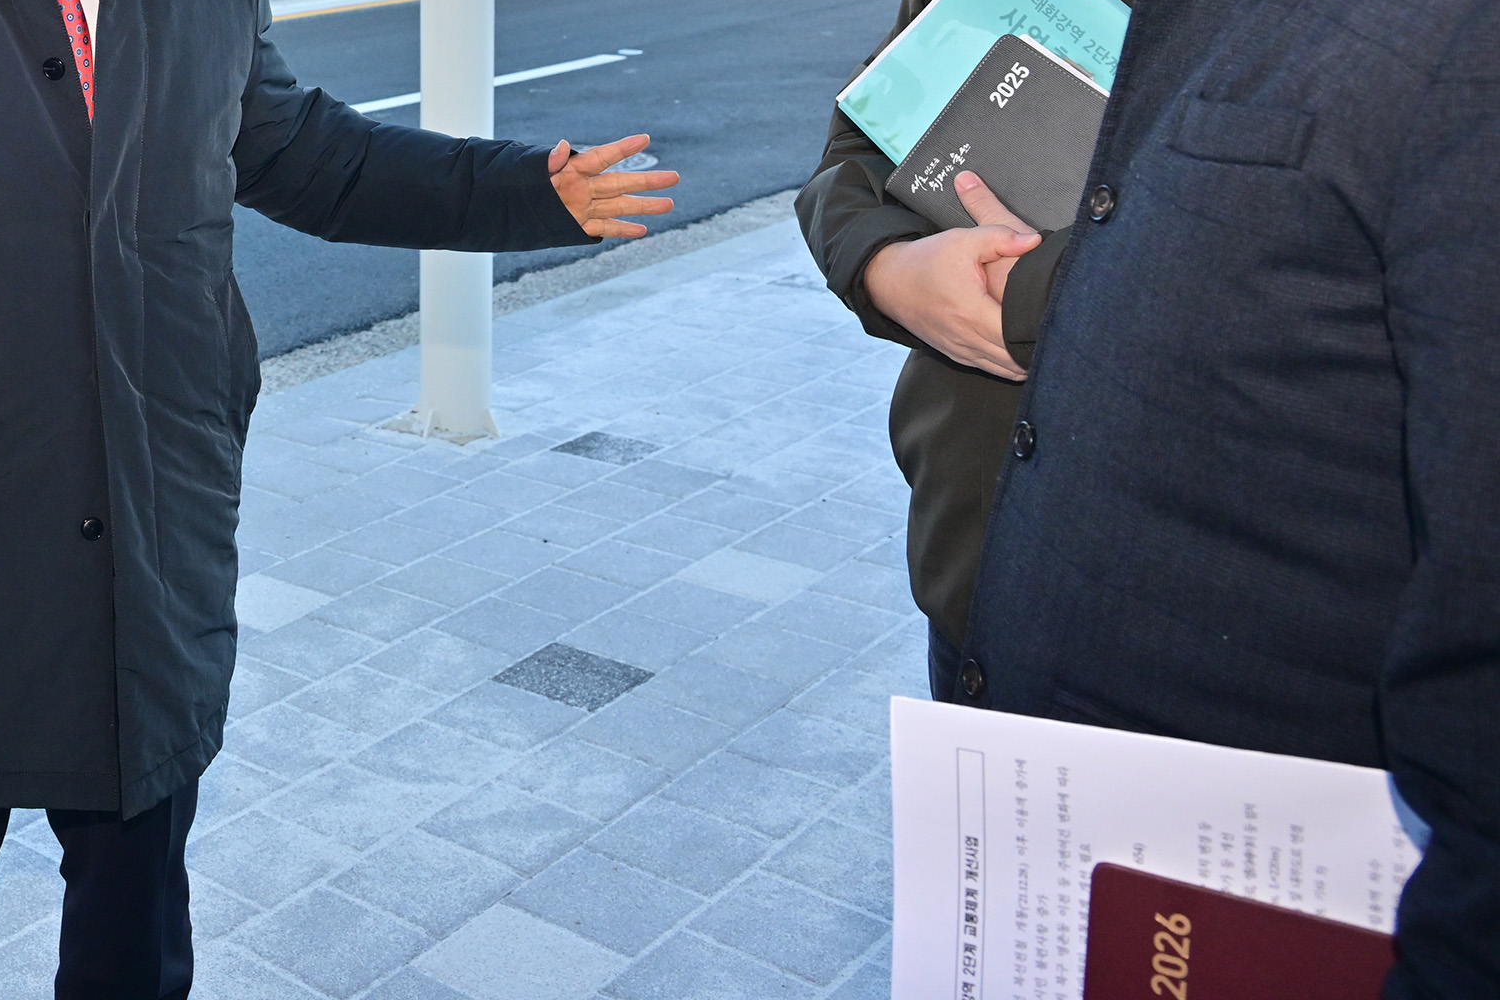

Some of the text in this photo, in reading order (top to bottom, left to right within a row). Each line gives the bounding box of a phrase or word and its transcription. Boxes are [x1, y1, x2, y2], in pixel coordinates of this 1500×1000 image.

[989, 62, 1030, 109] 2025
[963, 836, 978, 882] 개선사업
[963, 888, 978, 937] 교통체계
[963, 942, 977, 976] 2단계
[1150, 912, 1191, 1000] 2026
